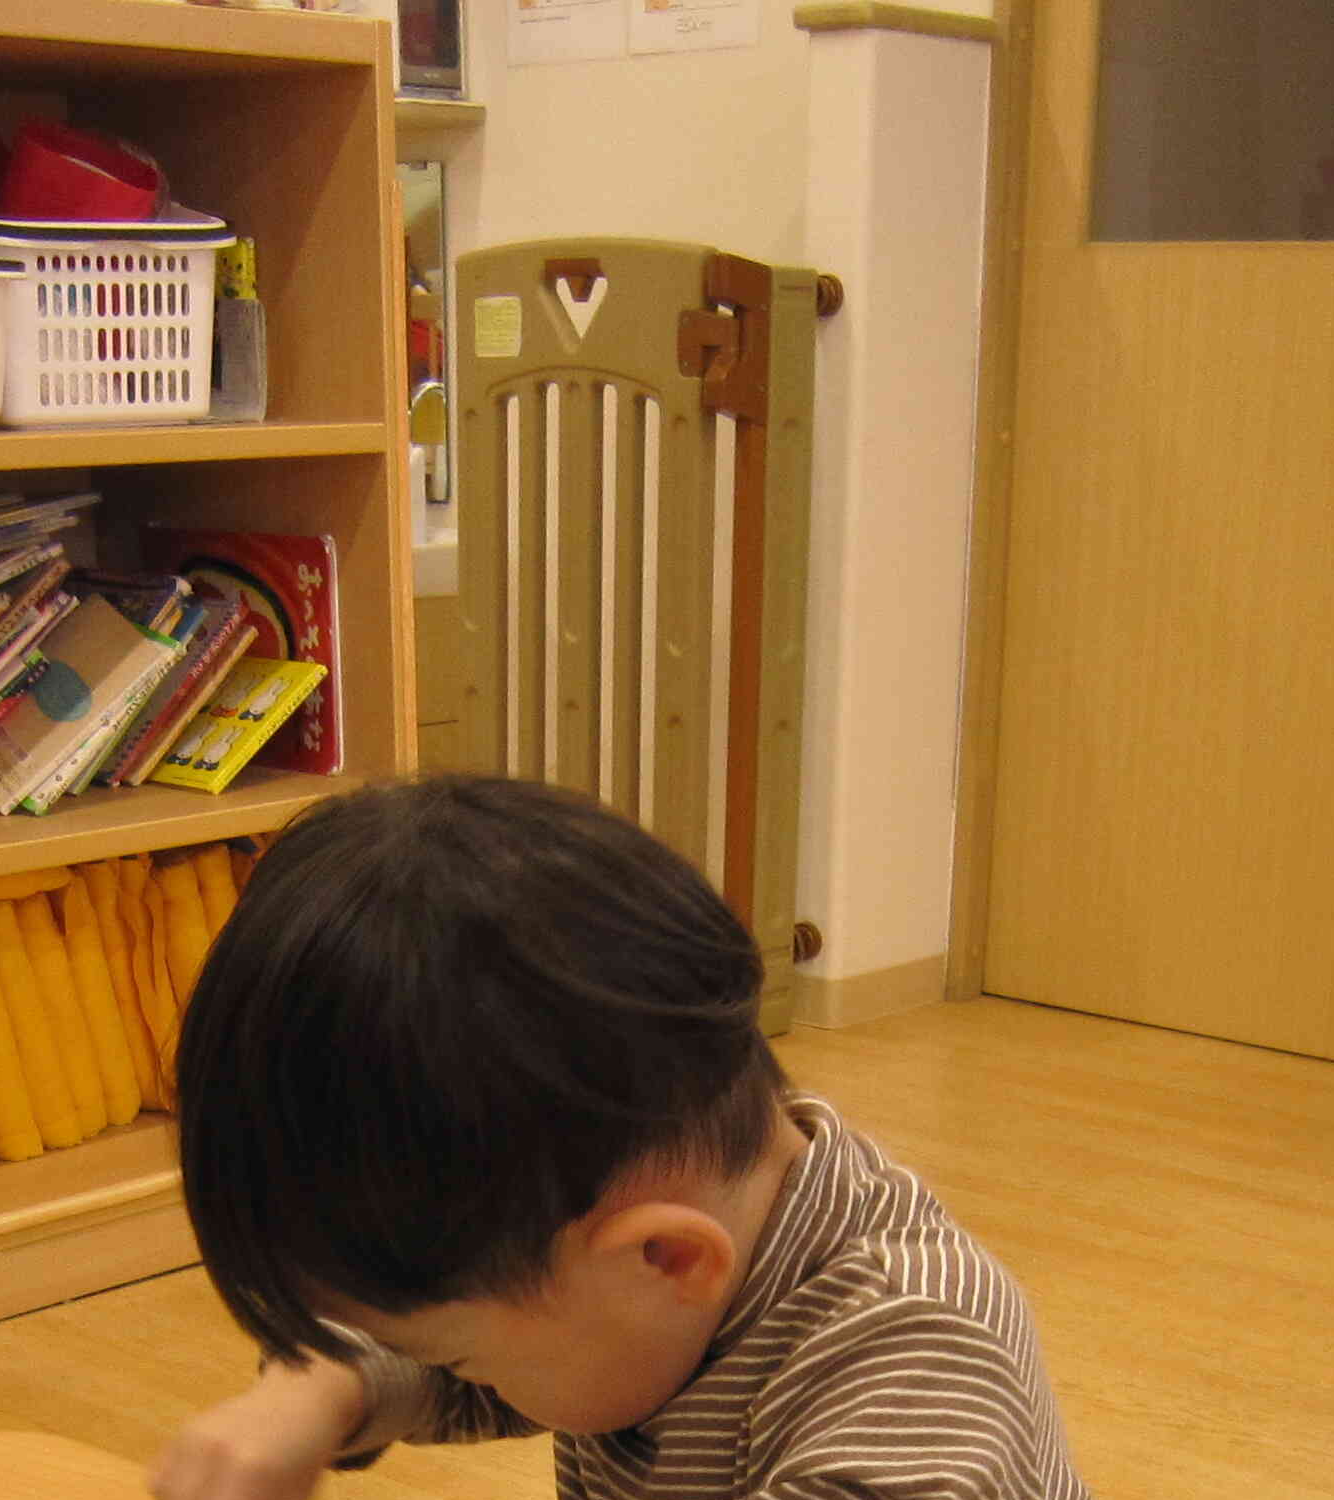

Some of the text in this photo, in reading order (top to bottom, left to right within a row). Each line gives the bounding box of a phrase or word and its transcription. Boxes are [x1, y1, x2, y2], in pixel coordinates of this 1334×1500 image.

[297, 562, 324, 753] おへそあな
